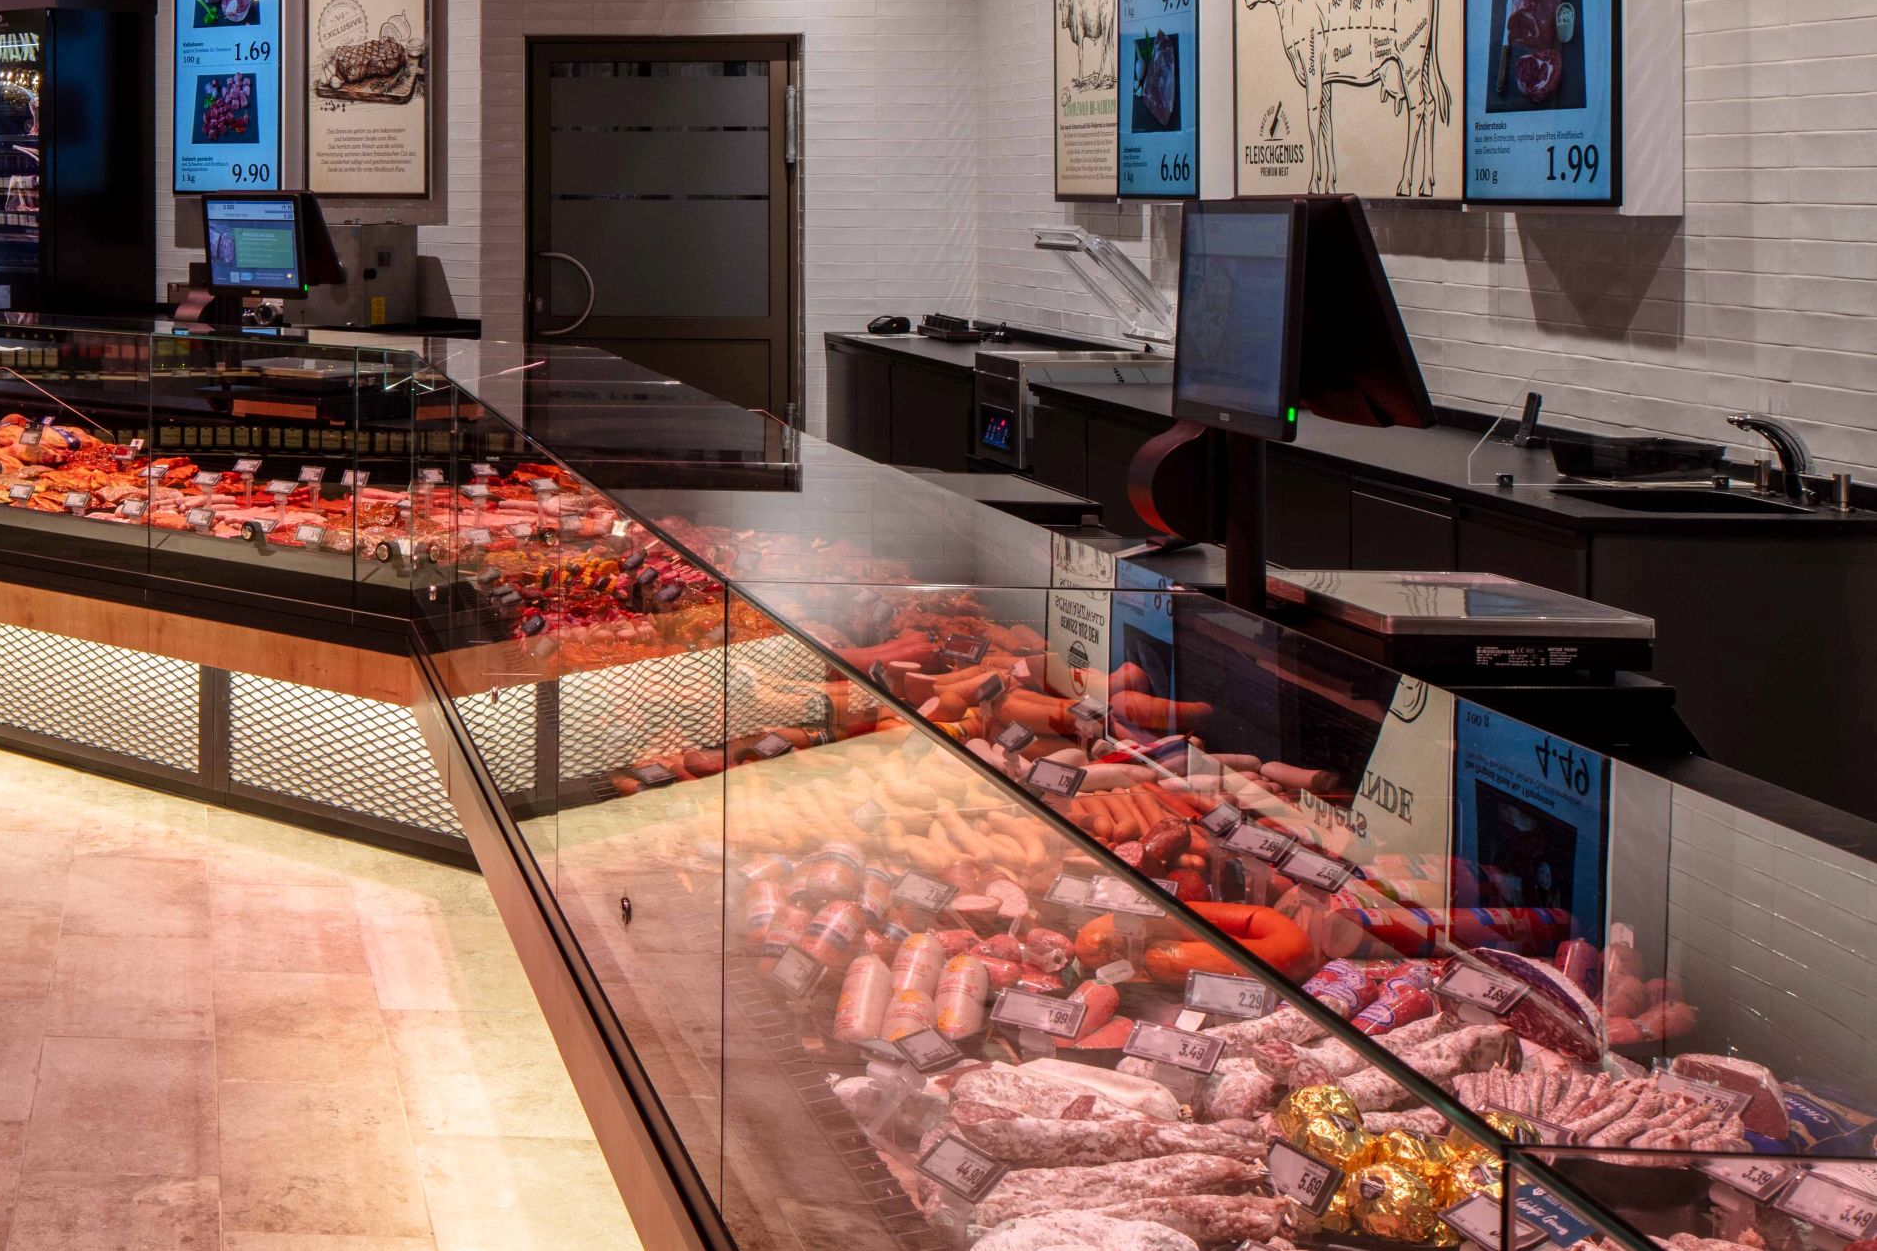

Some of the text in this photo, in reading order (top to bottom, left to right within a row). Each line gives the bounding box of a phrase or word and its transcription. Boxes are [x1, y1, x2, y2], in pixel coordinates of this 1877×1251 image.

[323, 17, 362, 41] EXCLUSIVE
[183, 56, 195, 64] 100
[235, 41, 271, 61] 1.69
[1475, 122, 1507, 131] Rindersteaks
[1246, 144, 1304, 164] FLEISCHGENUSS
[1546, 144, 1599, 183] 1.99
[232, 164, 270, 183] 9.90
[1161, 153, 1190, 181] 6.66
[1475, 169, 1498, 183] 100 g
[1238, 992, 1263, 1010] 2.29
[1482, 985, 1508, 1004] 3.69
[1048, 1008, 1070, 1025] 1.99
[1179, 1043, 1204, 1060] 3.49
[956, 1161, 985, 1184] 44.90
[1742, 1166, 1772, 1186] 3.39
[1297, 1172, 1323, 1197] 5.69
[1840, 1204, 1872, 1228] 3.49
